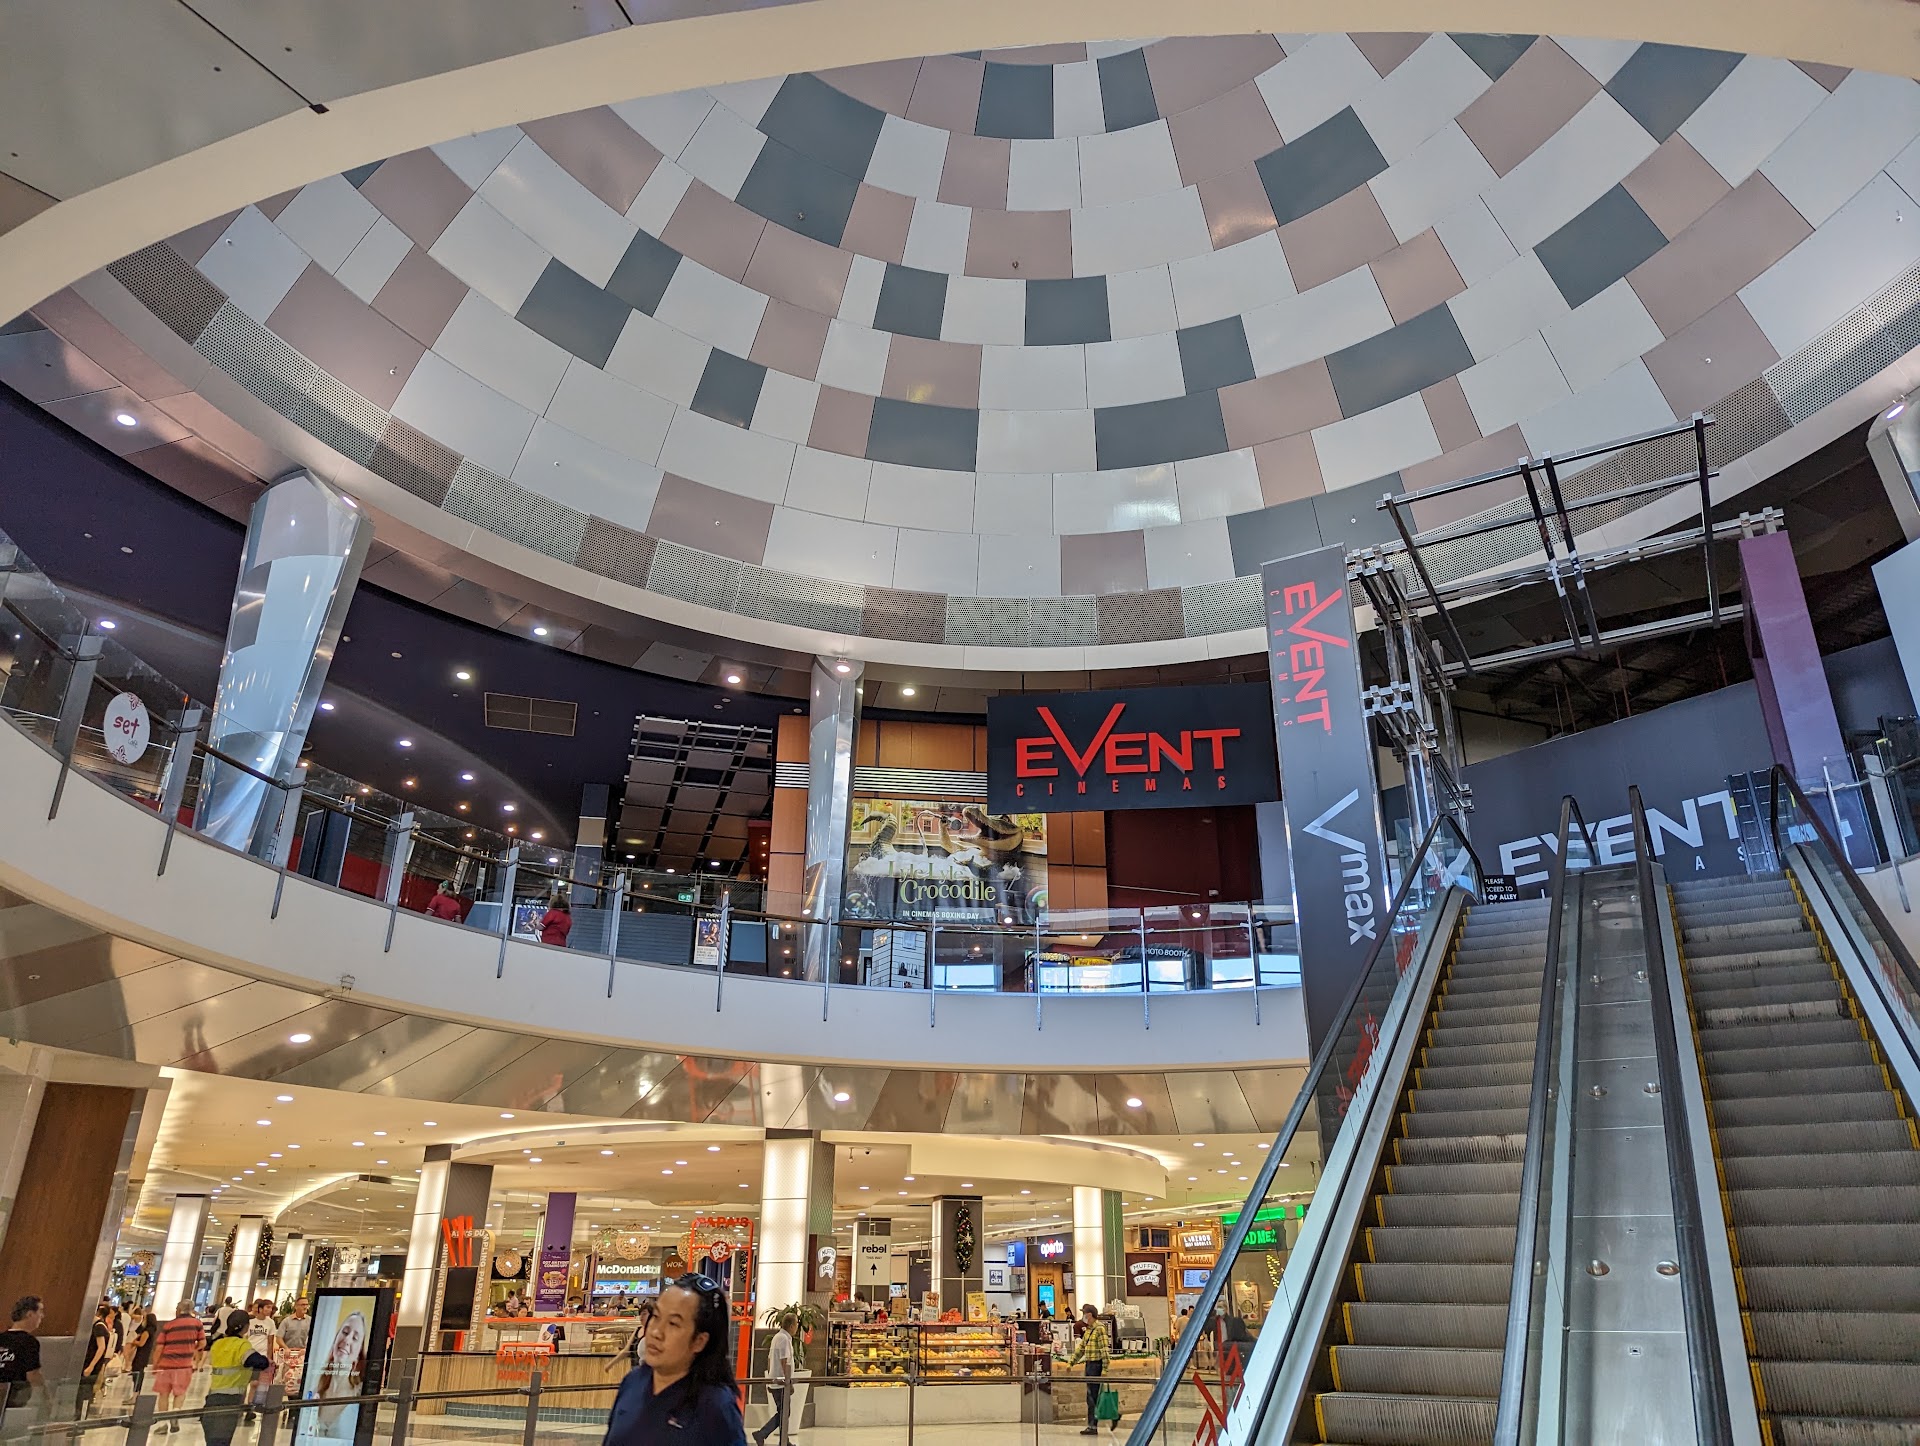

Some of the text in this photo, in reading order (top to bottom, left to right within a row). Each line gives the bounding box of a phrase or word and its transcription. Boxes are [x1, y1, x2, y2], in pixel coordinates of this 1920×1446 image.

[1269, 590, 1293, 727] CINEMAS
[1283, 581, 1349, 731] EVENT
[1016, 703, 1241, 779] EVENT
[1016, 775, 1227, 797] CINEMAS
[1302, 788, 1377, 946] Vmax
[900, 878, 996, 904] Crocodile
[1145, 948, 1187, 957] HOTO BOOTH
[862, 1244, 887, 1254] rebel
[1243, 1231, 1257, 1245] AD
[496, 1350, 550, 1367] PAPA'S
